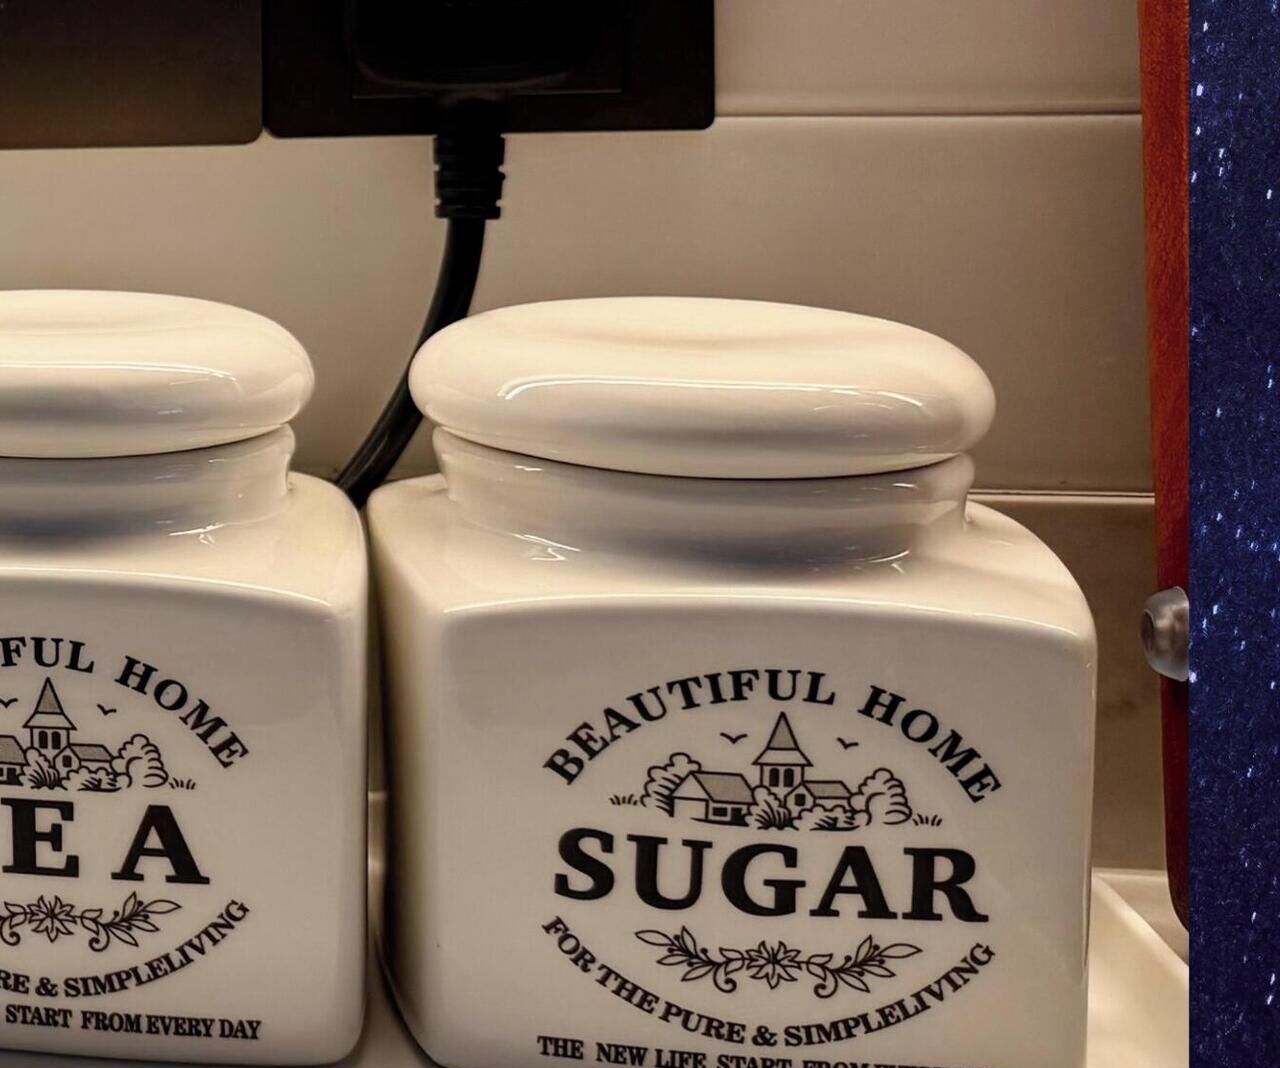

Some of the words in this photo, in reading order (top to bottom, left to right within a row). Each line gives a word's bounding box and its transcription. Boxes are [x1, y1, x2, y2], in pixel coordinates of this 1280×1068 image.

[114, 655, 250, 769] HOME
[542, 668, 837, 787] BEAUTIFUL
[857, 684, 1003, 804] HOME
[552, 827, 990, 923] SUGAR
[5, 1005, 73, 1028] START
[81, 1010, 142, 1033] FROM
[146, 1015, 216, 1038] EVERY
[218, 1019, 262, 1041] DAY
[34, 977, 59, 998] &
[541, 915, 594, 975] FOR
[596, 963, 660, 1015] THE
[658, 1002, 746, 1045] PURE
[751, 1025, 778, 1048] &
[536, 1035, 584, 1060] THE
[595, 1041, 648, 1067] NEW
